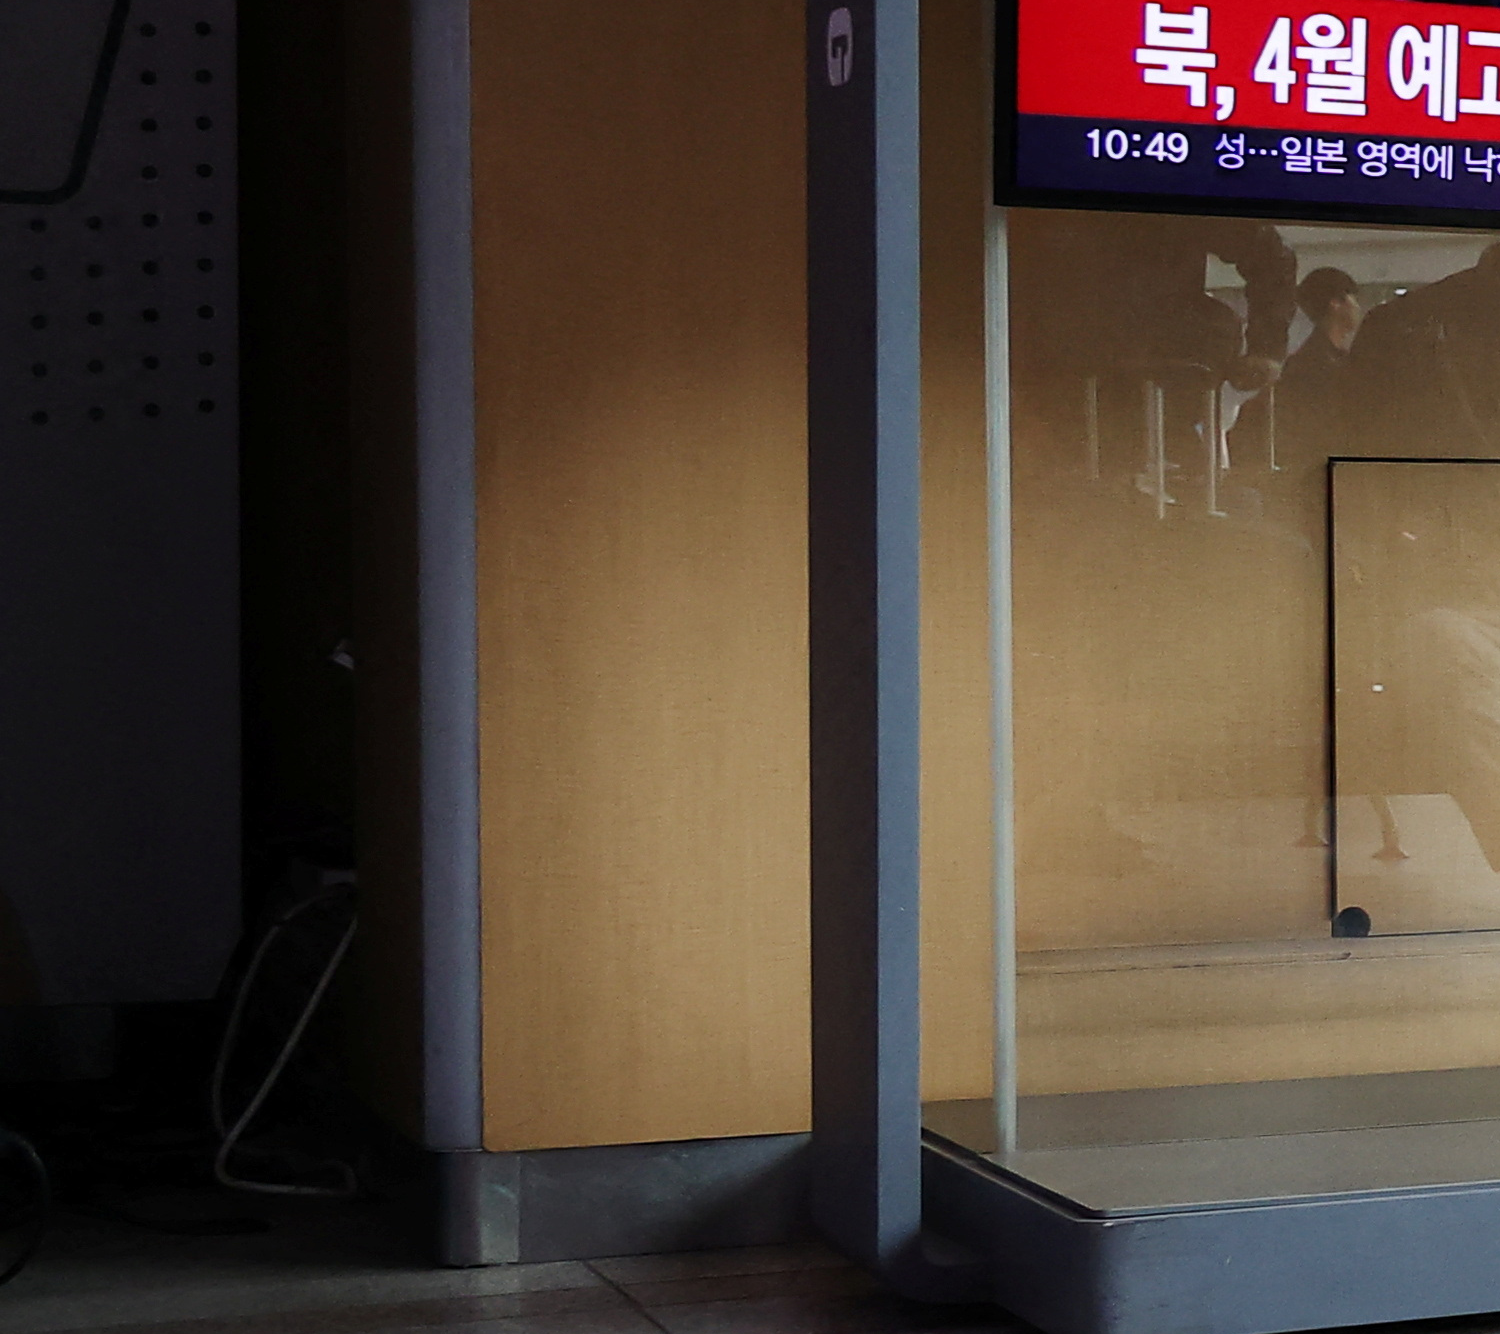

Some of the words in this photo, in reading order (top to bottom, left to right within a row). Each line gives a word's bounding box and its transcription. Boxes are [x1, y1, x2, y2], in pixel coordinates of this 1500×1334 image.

[1135, 2, 1236, 122] 북,
[1252, 14, 1370, 118] 4월
[1086, 127, 1190, 164] 10:49
[1356, 140, 1455, 182] 영역에
